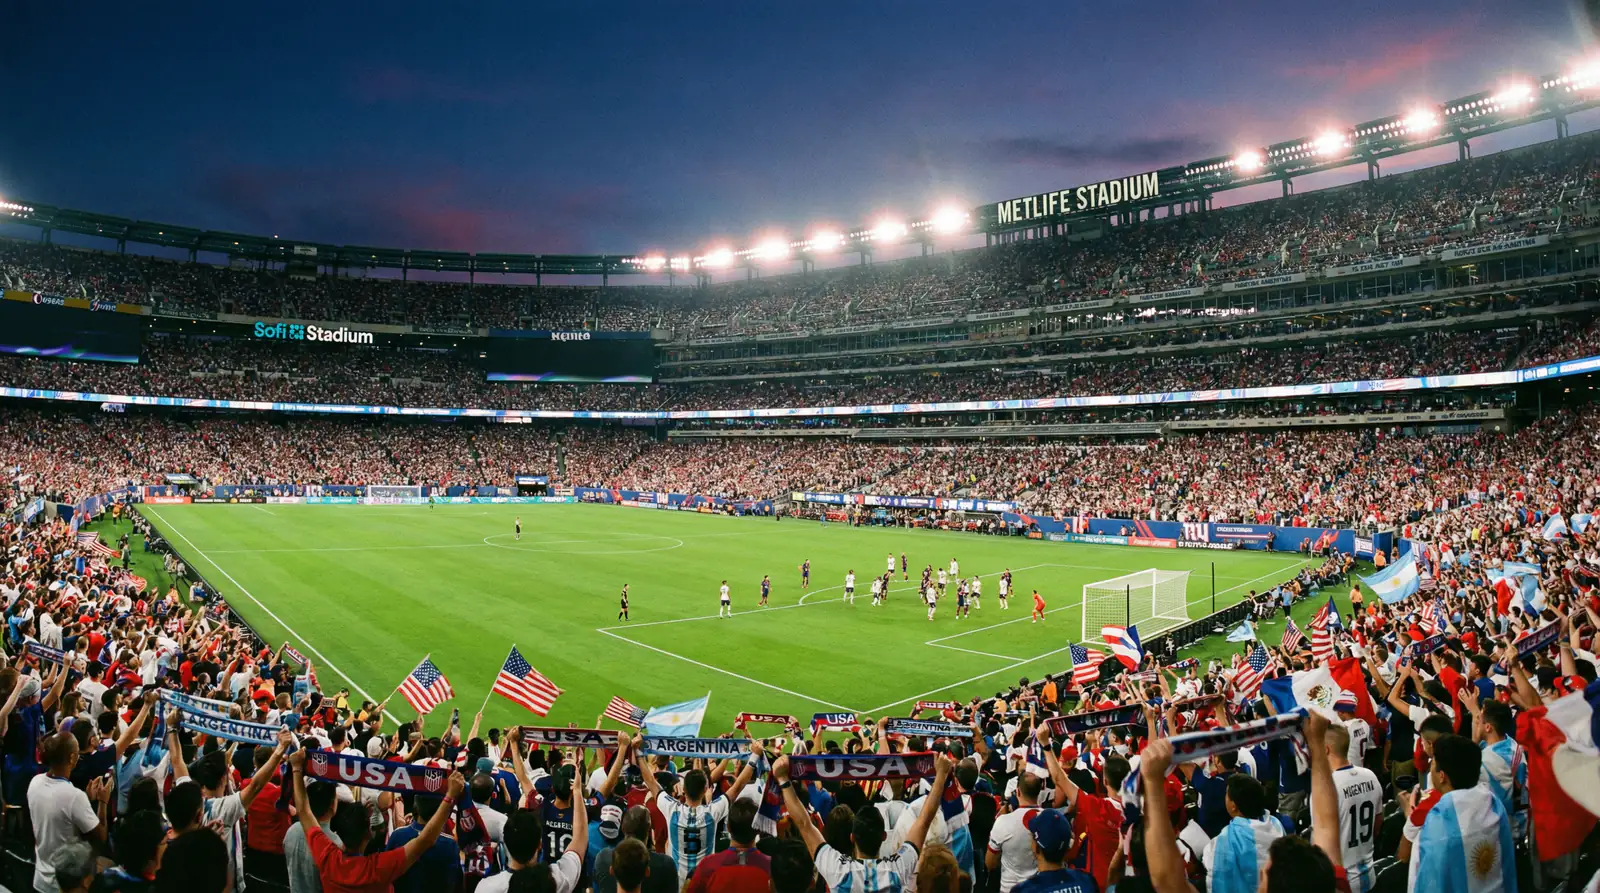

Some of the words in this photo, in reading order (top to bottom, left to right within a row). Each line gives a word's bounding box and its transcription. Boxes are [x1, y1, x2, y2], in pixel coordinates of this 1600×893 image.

[998, 189, 1071, 224] METLIFE
[1076, 171, 1159, 210] STADIUM
[254, 321, 287, 339] Sofi
[306, 324, 373, 344] Stadium
[189, 714, 273, 742] ARGENTINA
[750, 714, 787, 724] USA
[826, 713, 855, 724] USA
[656, 739, 740, 754] ARGENTINA
[338, 758, 414, 790] USA
[815, 758, 910, 778] USA
[1348, 801, 1374, 848] 19
[684, 828, 702, 854] 5
